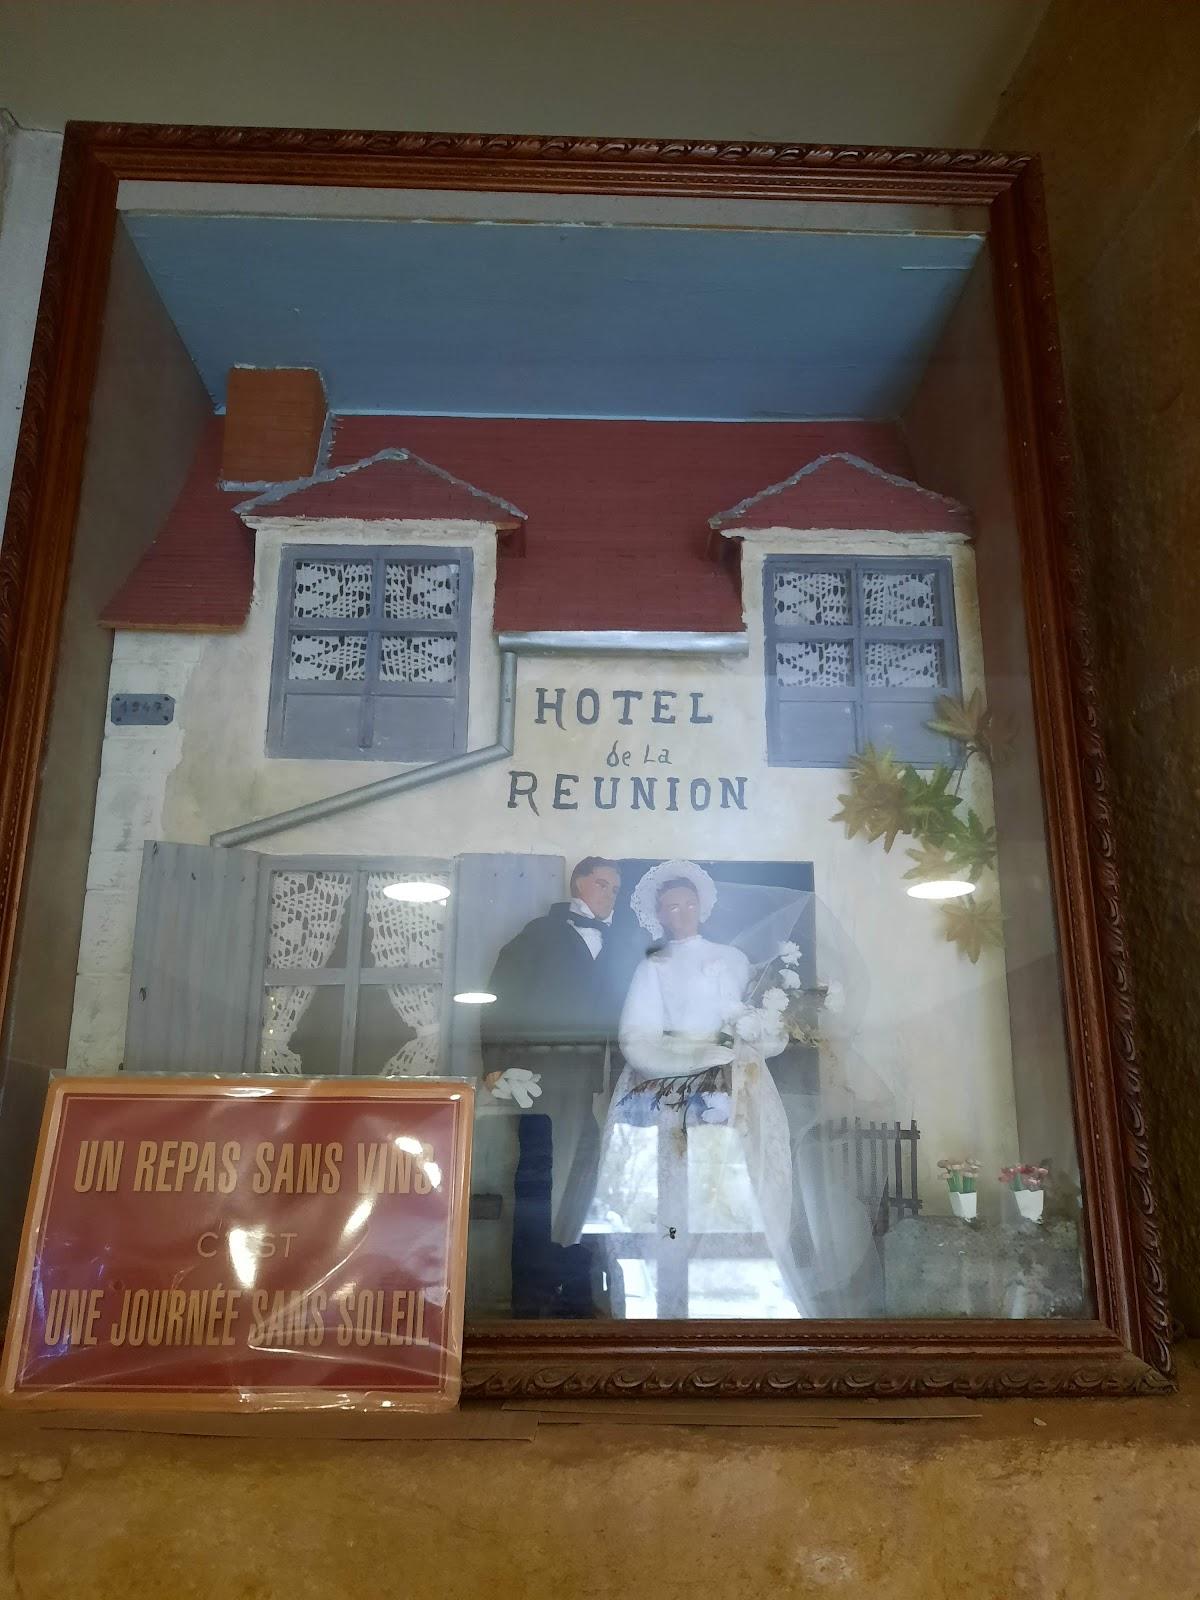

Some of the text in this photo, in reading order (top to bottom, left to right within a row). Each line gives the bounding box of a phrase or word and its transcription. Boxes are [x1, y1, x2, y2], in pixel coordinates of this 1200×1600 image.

[534, 687, 713, 730] HOTEL
[606, 740, 631, 767] de
[507, 770, 748, 816] REUNION
[73, 1140, 124, 1193] UN
[133, 1140, 242, 1195] REPAS
[252, 1142, 343, 1195] SANS
[44, 1282, 431, 1347] UNE JOURNÉE SANS SOLEIL
